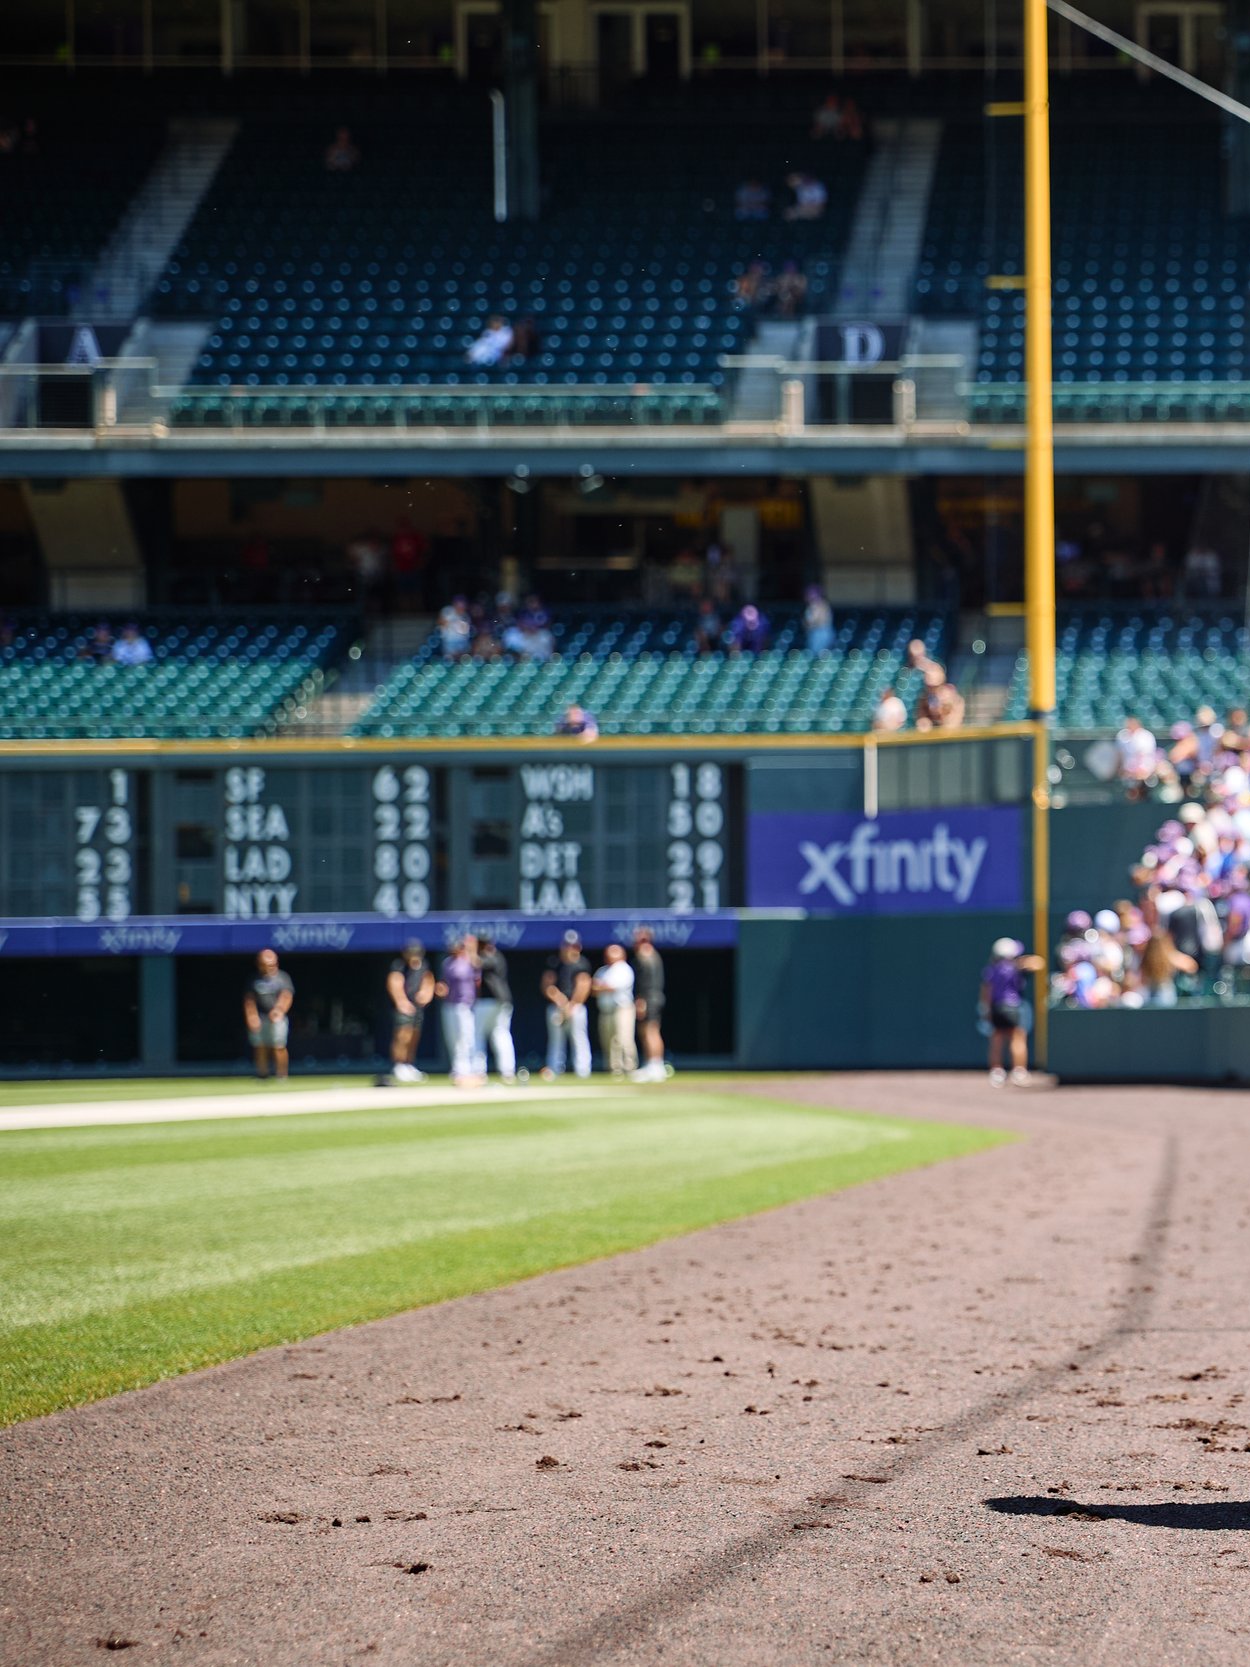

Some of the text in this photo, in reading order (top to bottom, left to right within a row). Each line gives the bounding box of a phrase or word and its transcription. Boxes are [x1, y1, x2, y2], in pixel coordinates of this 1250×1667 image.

[841, 322, 884, 368] D
[110, 768, 128, 805] 1
[225, 765, 430, 804] SF 62
[520, 762, 722, 801] WSH 18
[75, 806, 131, 844] 73
[225, 803, 430, 842] SEA 22
[75, 848, 131, 886] 23
[224, 842, 430, 882] LAD 80
[519, 840, 723, 880] DET 29
[799, 822, 988, 906] xfinity
[224, 881, 430, 920] NYY 40
[519, 879, 720, 916] LAA 21
